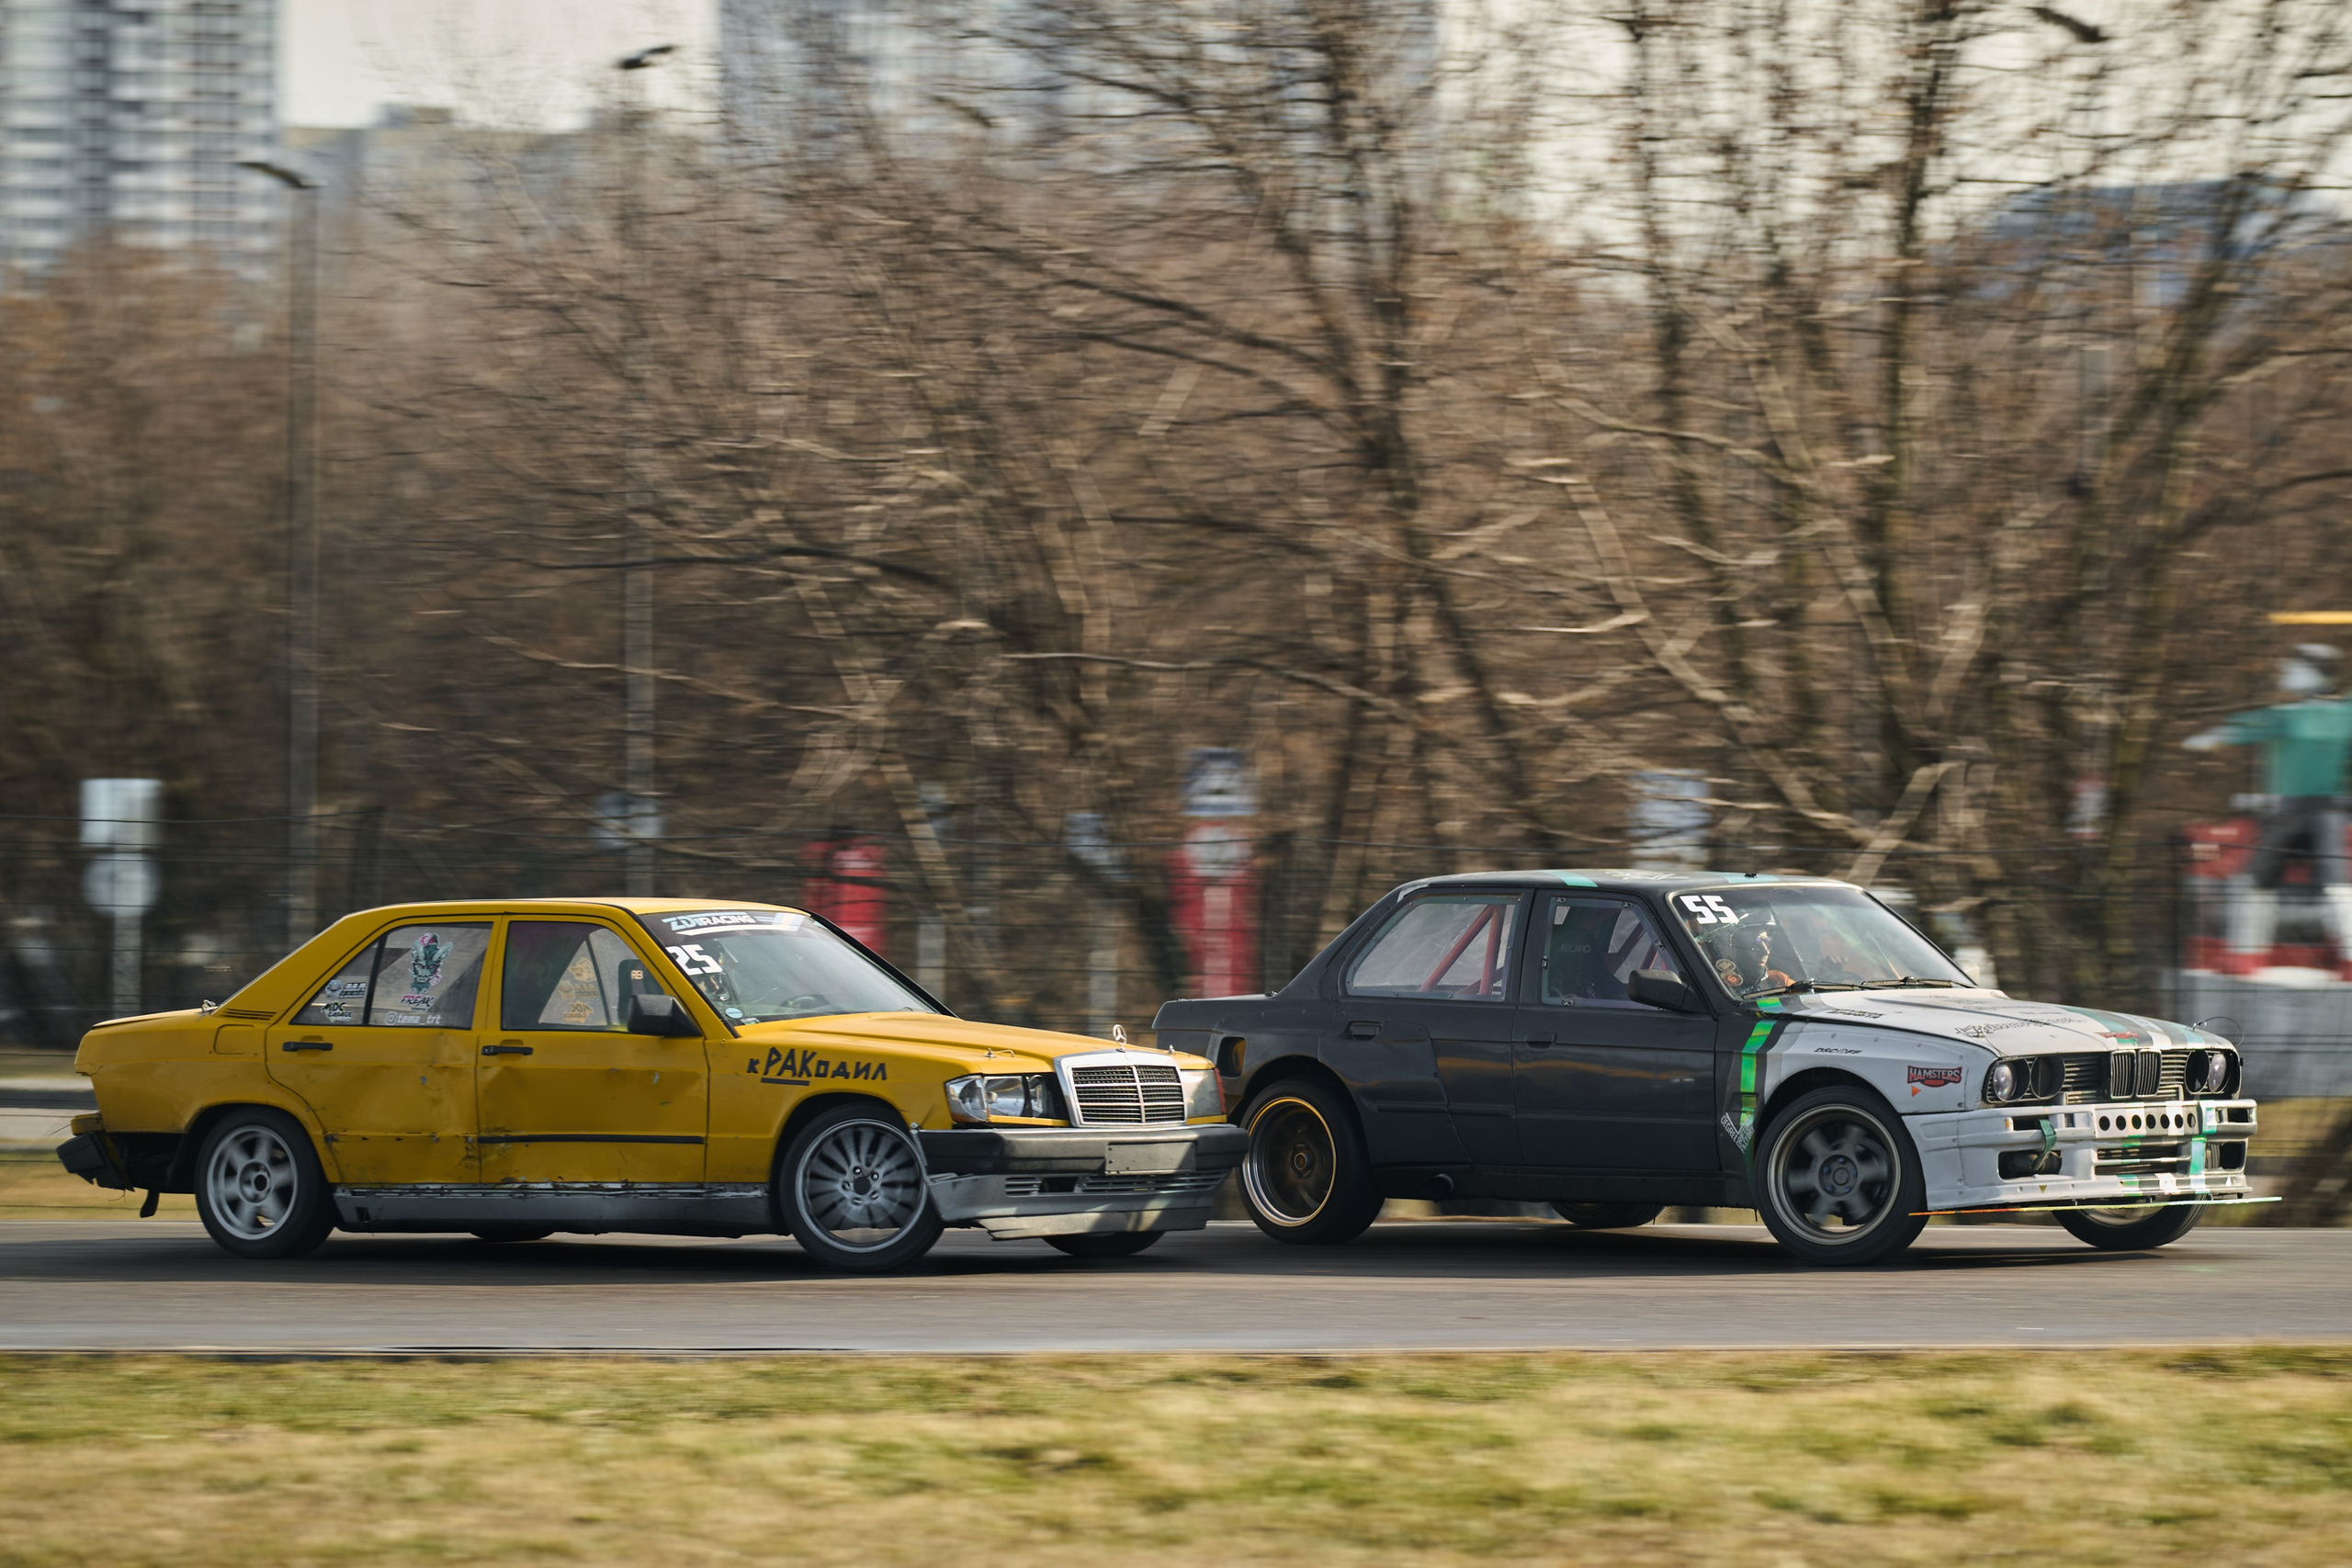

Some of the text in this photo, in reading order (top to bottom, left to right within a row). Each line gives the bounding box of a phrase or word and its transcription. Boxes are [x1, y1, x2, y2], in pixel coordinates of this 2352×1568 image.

[1679, 895, 1739, 924] 55
[665, 943, 723, 976] 25
[322, 1001, 346, 1012] MDC
[400, 995, 435, 1008] FREAK
[1908, 1066, 1961, 1082] HAMSTERS
[1720, 1114, 1738, 1143] DEGREE
